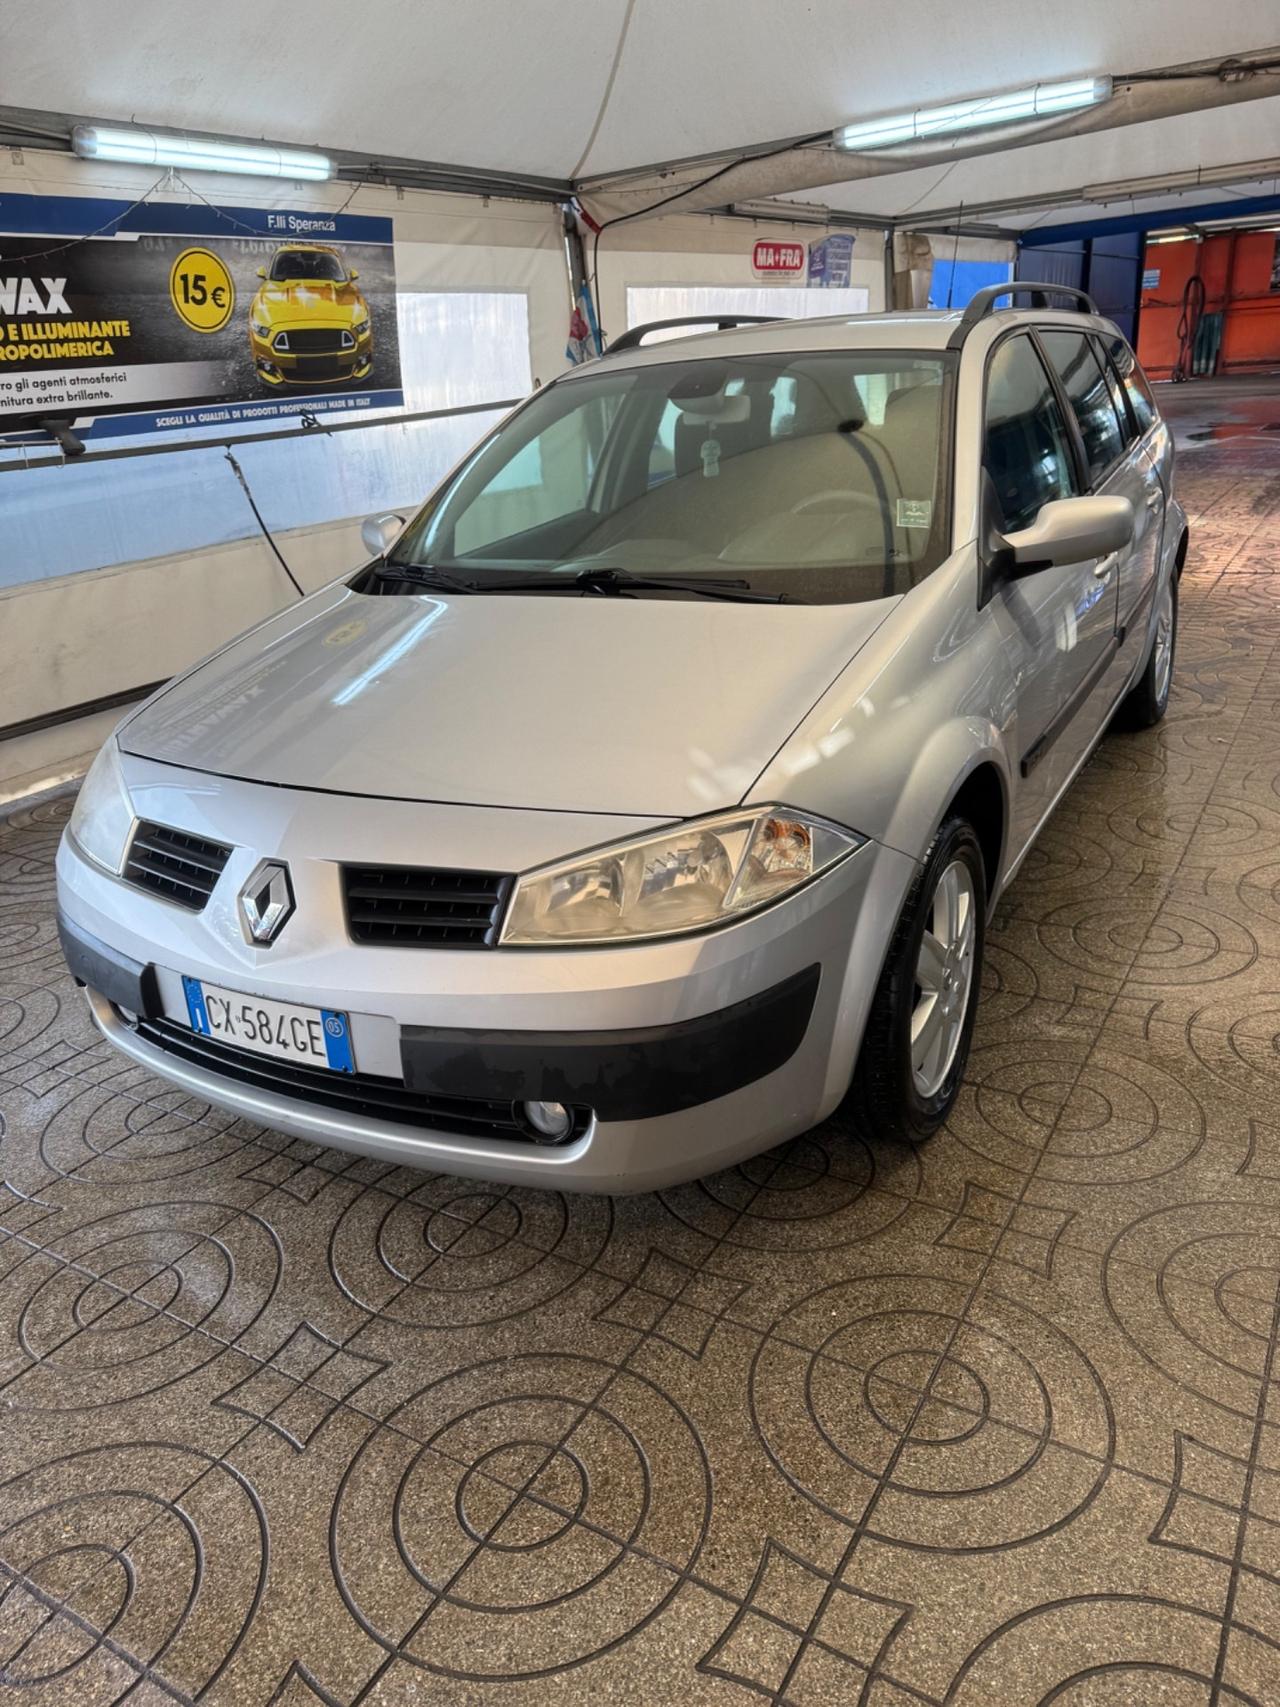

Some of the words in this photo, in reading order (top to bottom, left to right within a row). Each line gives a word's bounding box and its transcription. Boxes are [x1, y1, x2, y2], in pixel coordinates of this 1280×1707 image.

[288, 215, 336, 233] Speranza
[7, 323, 19, 341] E
[21, 320, 131, 341] ILLUMINANTE
[15, 377, 29, 393] gli
[32, 376, 67, 391] agenti
[69, 372, 127, 386] atmosferici
[36, 393, 64, 405] extra
[66, 389, 113, 402] brillante.
[156, 415, 183, 427] SCEGLI
[185, 414, 197, 424] LA
[198, 408, 230, 422] QUALITÀ
[232, 409, 241, 419] DI
[242, 406, 278, 418] PRODOTTI
